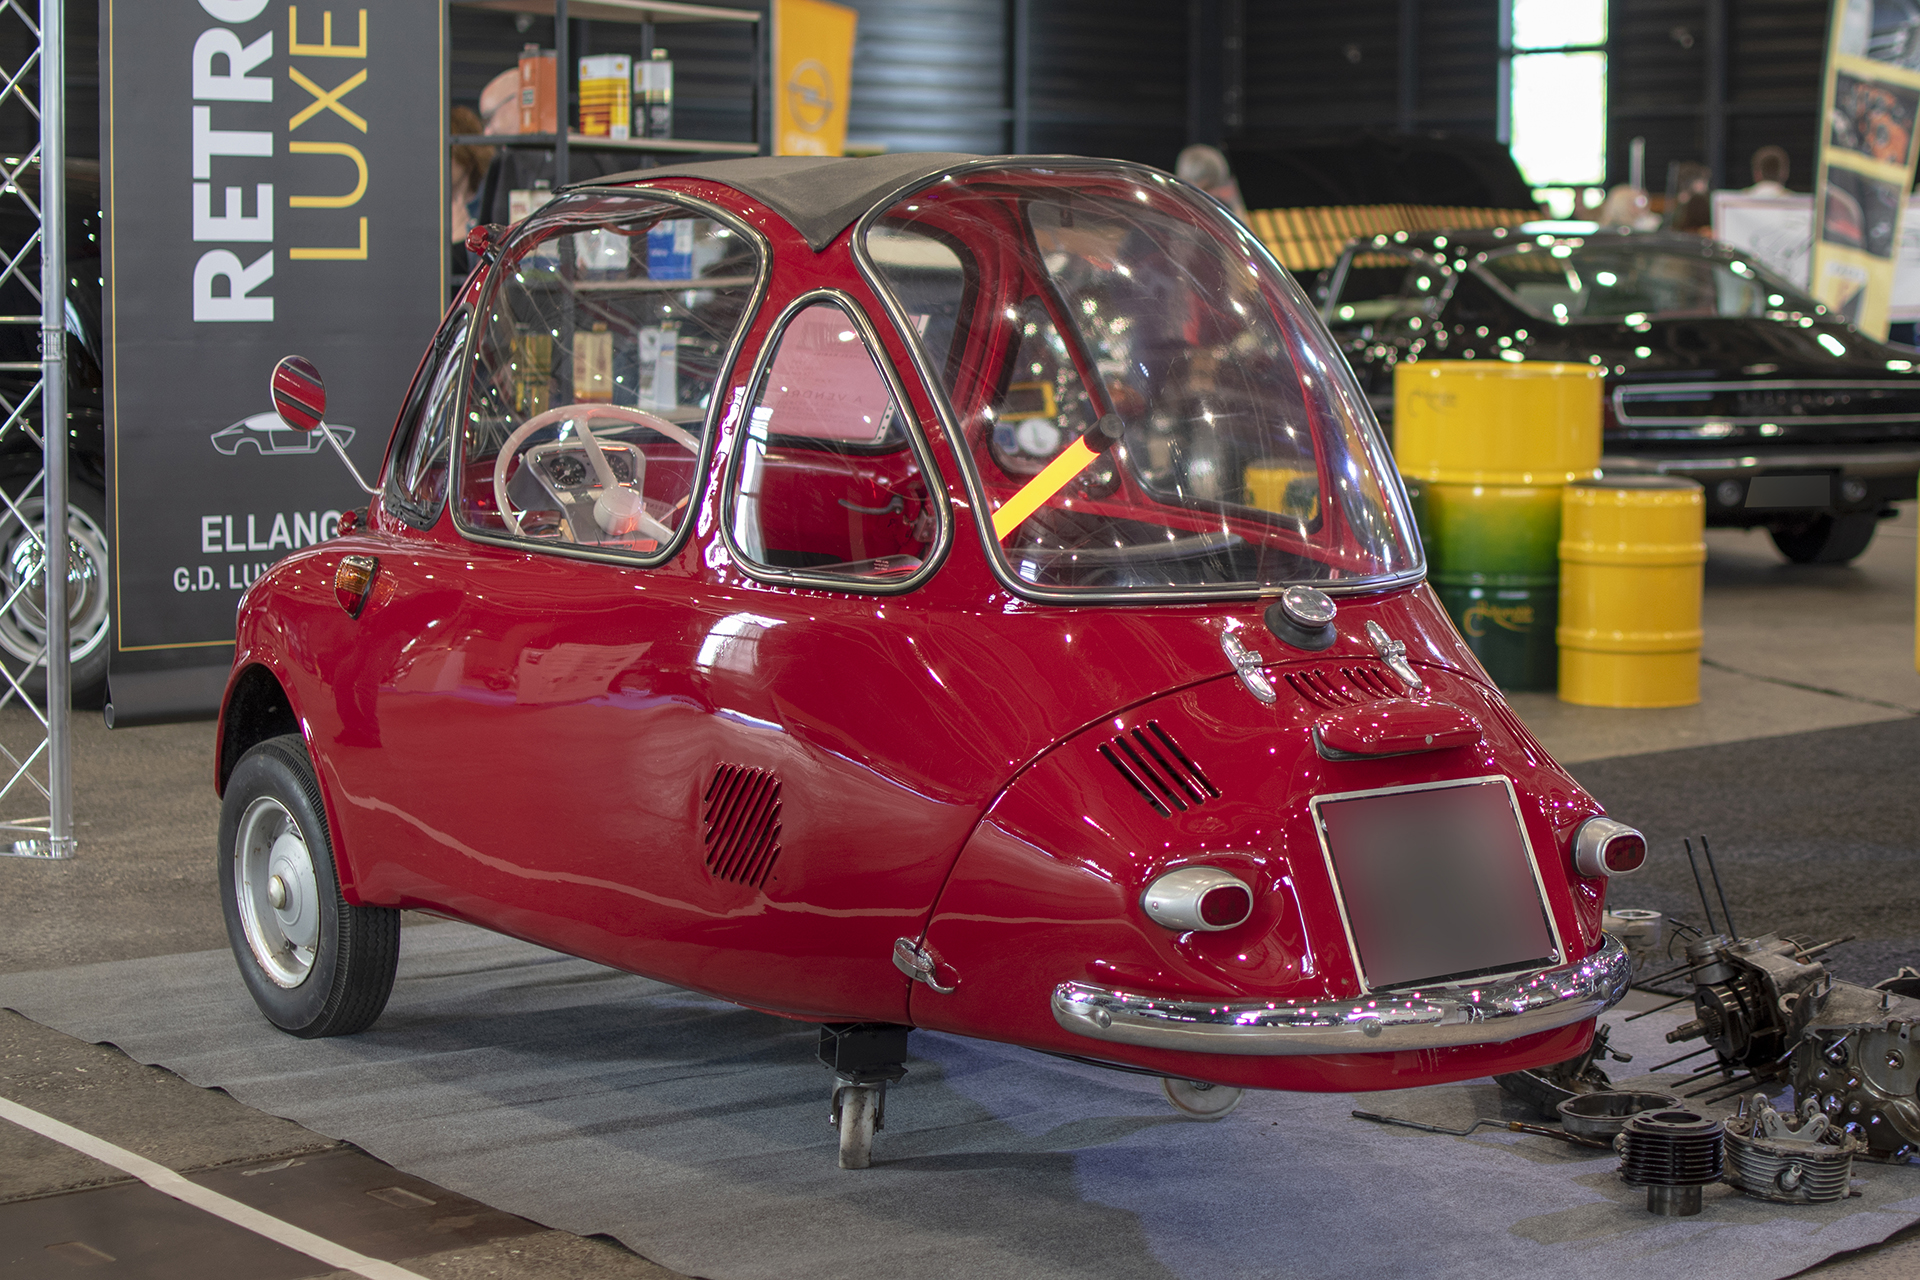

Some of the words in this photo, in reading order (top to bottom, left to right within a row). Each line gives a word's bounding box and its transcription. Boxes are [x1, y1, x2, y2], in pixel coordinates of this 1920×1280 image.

[193, 0, 274, 321] RETR
[289, 5, 368, 260] LUXE
[173, 566, 221, 592] G.D.
[202, 509, 343, 553] ELLANG
